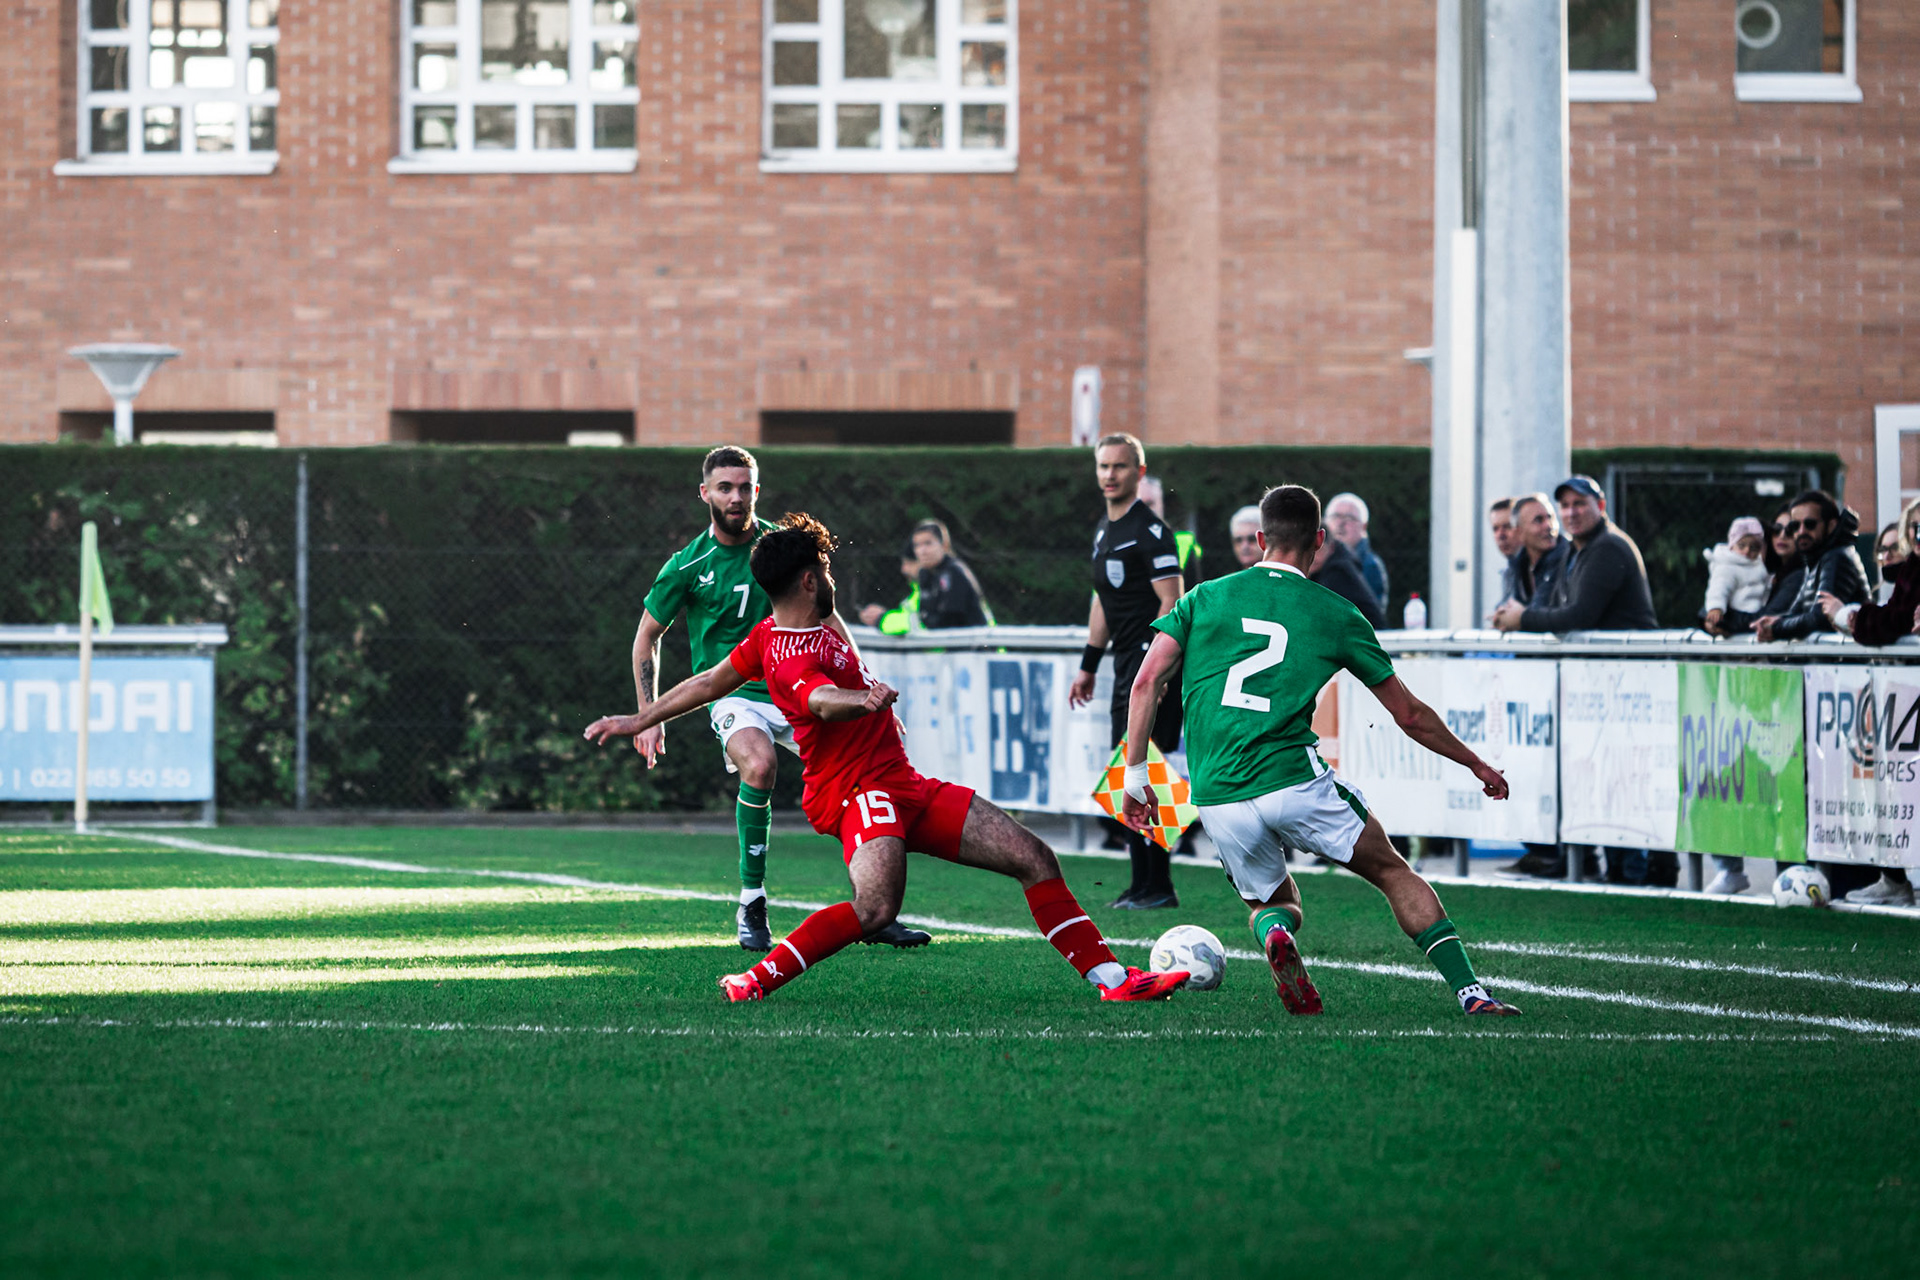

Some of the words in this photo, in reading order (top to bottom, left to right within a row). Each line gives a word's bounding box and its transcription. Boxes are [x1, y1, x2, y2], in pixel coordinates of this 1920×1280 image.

[733, 583, 750, 619] 7
[1221, 617, 1289, 713] 2
[0, 680, 193, 733] NDAI
[30, 768, 73, 788] 022
[126, 769, 155, 788] 50
[160, 769, 191, 788] 50
[856, 789, 897, 829] 15
[1888, 804, 1899, 820] 38
[1901, 804, 1914, 820] 33
